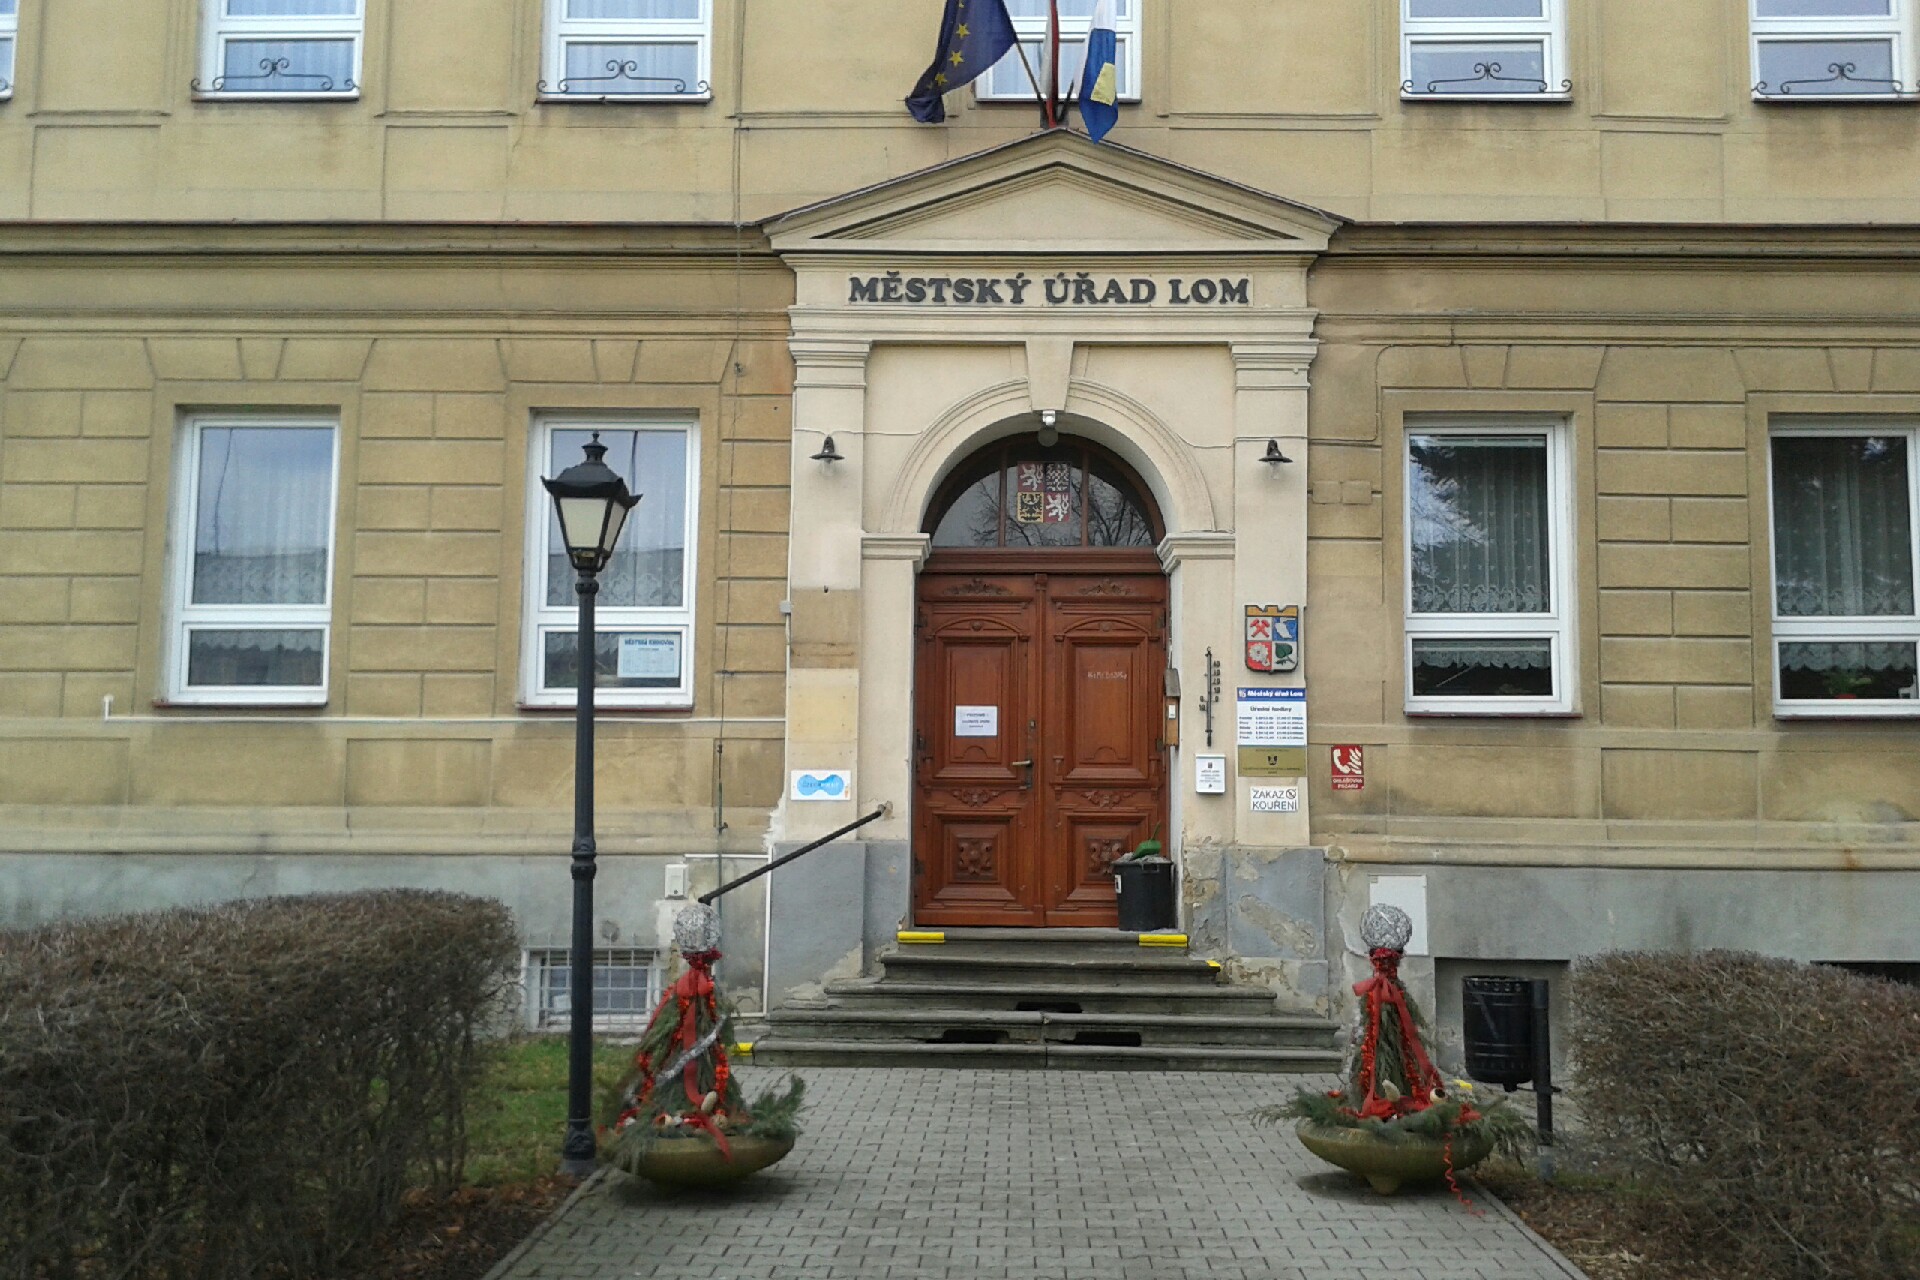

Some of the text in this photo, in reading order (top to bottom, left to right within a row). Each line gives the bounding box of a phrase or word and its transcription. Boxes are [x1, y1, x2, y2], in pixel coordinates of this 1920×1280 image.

[849, 271, 1249, 304] MĚSTSKÝ ÚŘAD LOM
[1252, 799, 1297, 810] KOUŘENÍ
